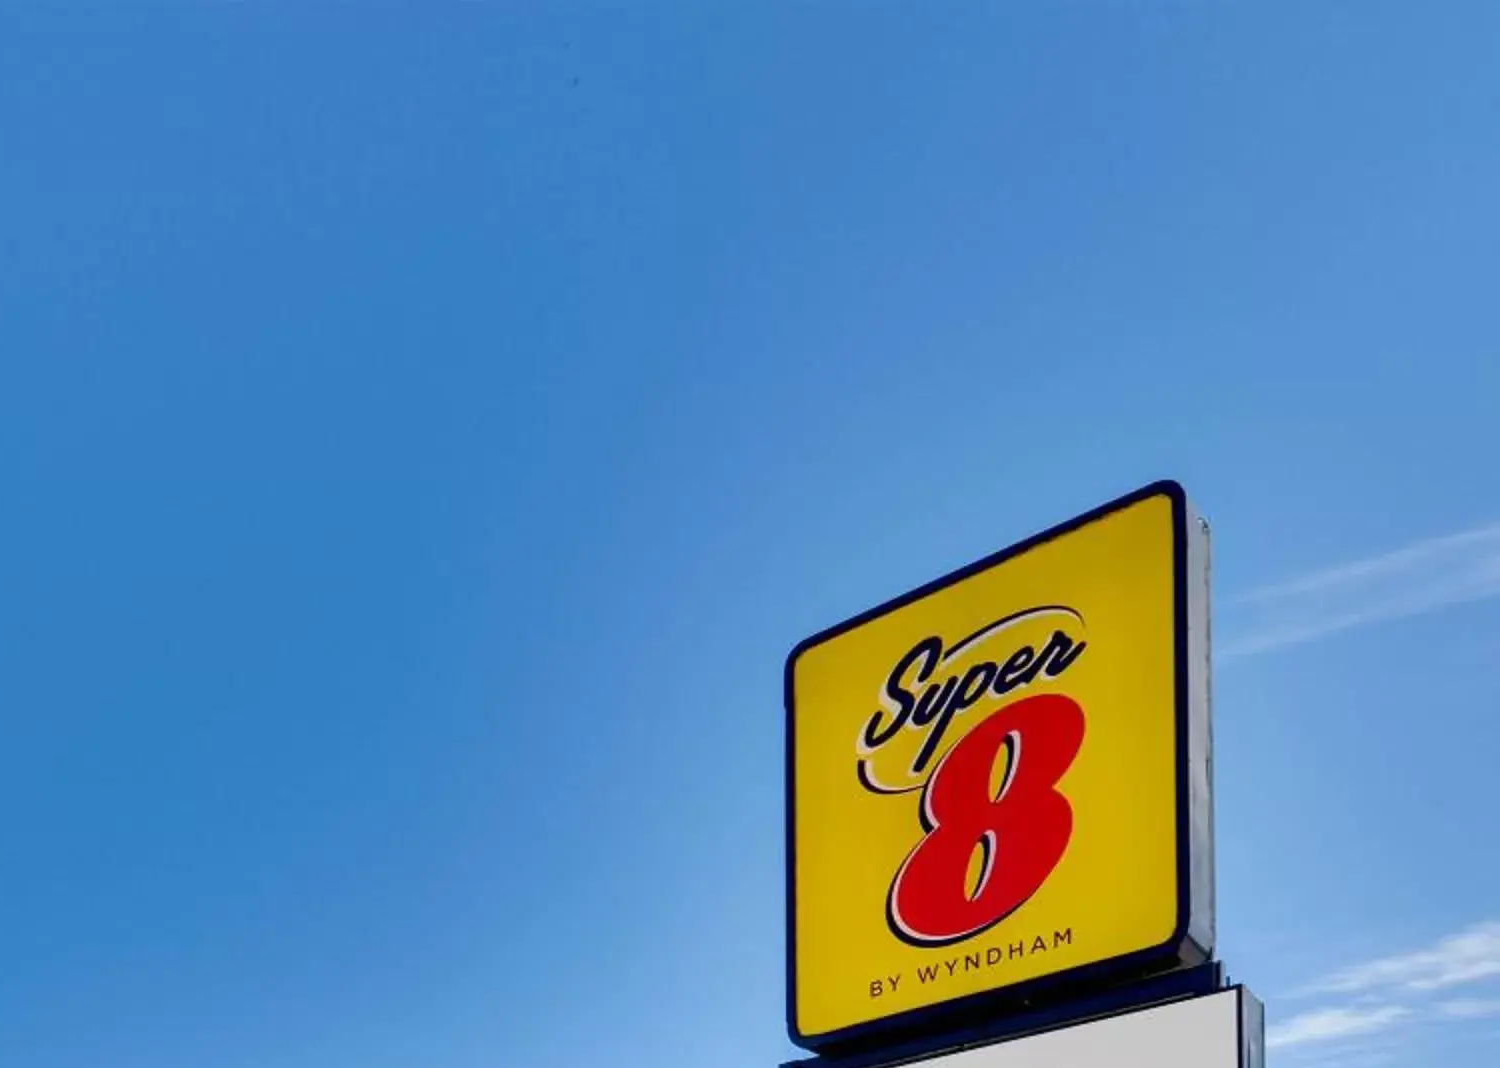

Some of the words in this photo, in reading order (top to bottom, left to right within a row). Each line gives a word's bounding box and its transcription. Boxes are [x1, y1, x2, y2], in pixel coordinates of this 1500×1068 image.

[859, 633, 1086, 774] Super
[886, 693, 1086, 948] 8
[869, 974, 902, 999] BY
[917, 927, 1074, 984] WYNDHAM
